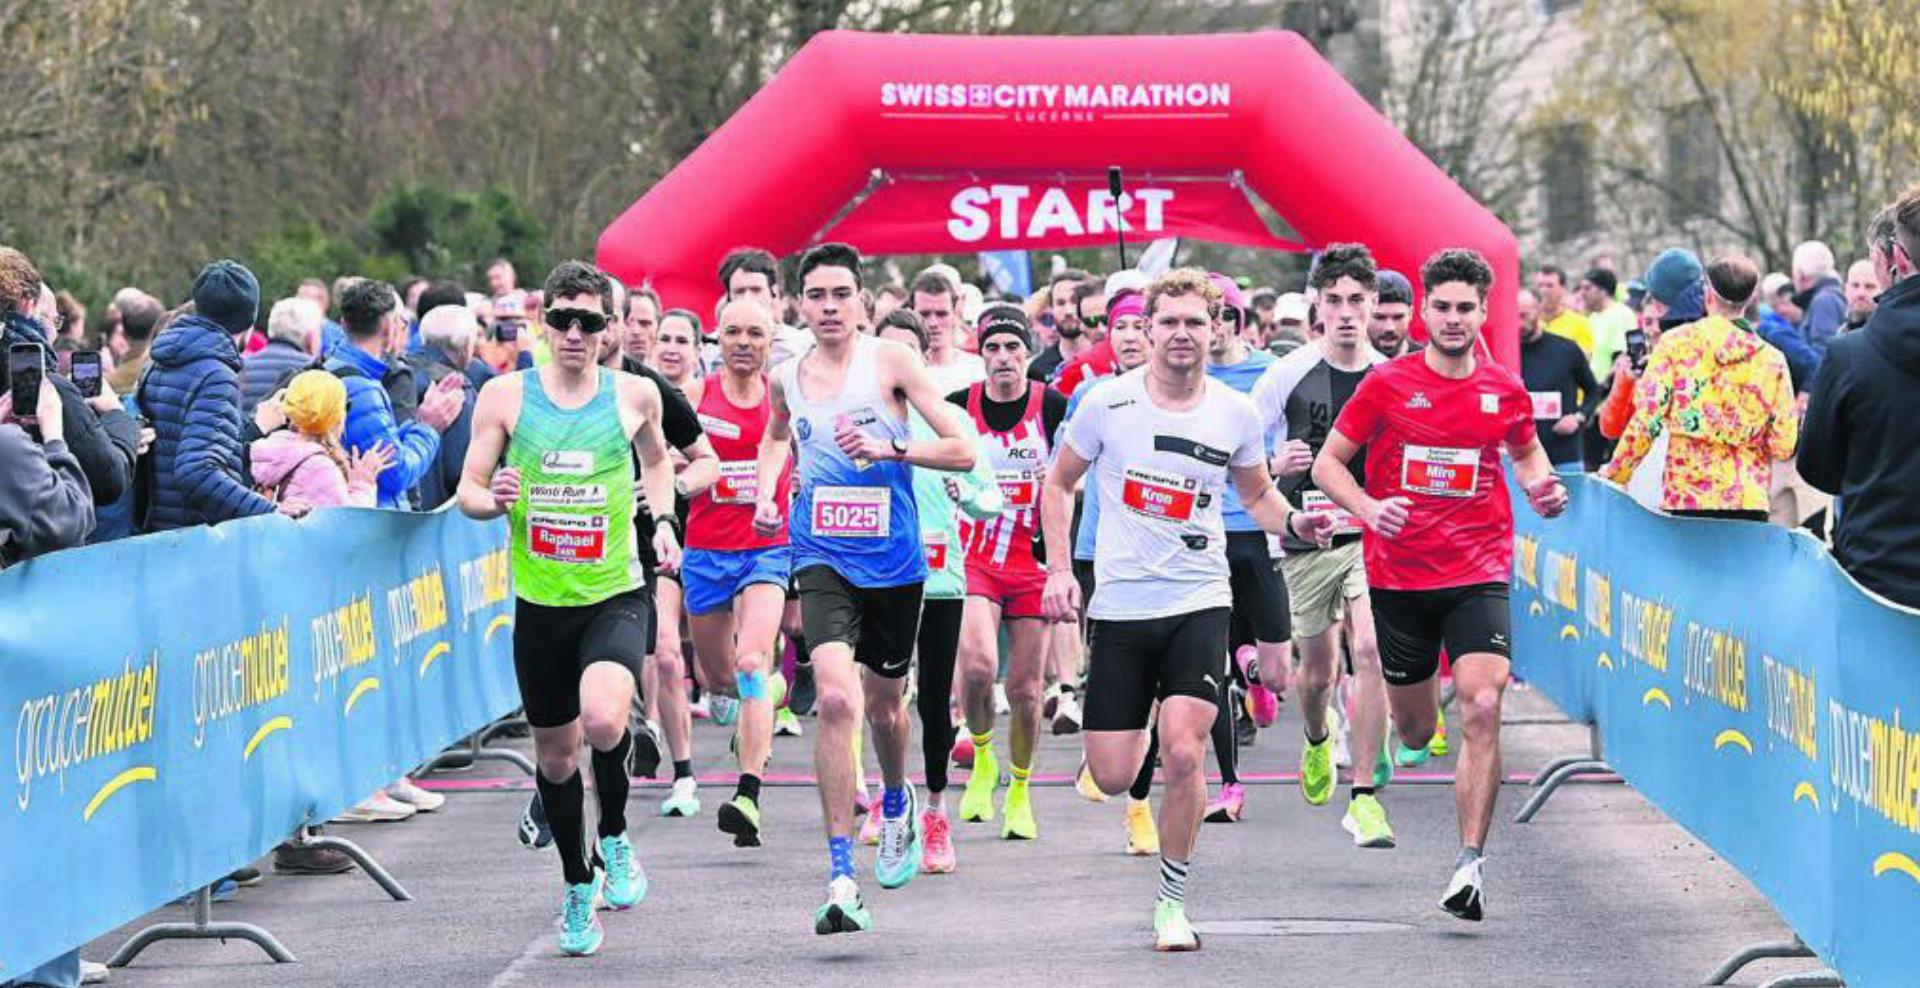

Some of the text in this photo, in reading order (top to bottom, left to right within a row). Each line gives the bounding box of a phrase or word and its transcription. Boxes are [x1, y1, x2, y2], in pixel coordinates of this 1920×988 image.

[881, 82, 1231, 108] SWISS CITY MARATHON
[947, 185, 1174, 241] START
[1425, 464, 1457, 478] Miro
[562, 486, 586, 497] Run
[1141, 486, 1173, 505] Kron
[821, 504, 878, 528] 5025
[540, 530, 596, 547] Raphael
[193, 614, 289, 748] groupemutuel
[16, 648, 158, 812] groupemutuel
[1828, 696, 1920, 836] groupemutue
